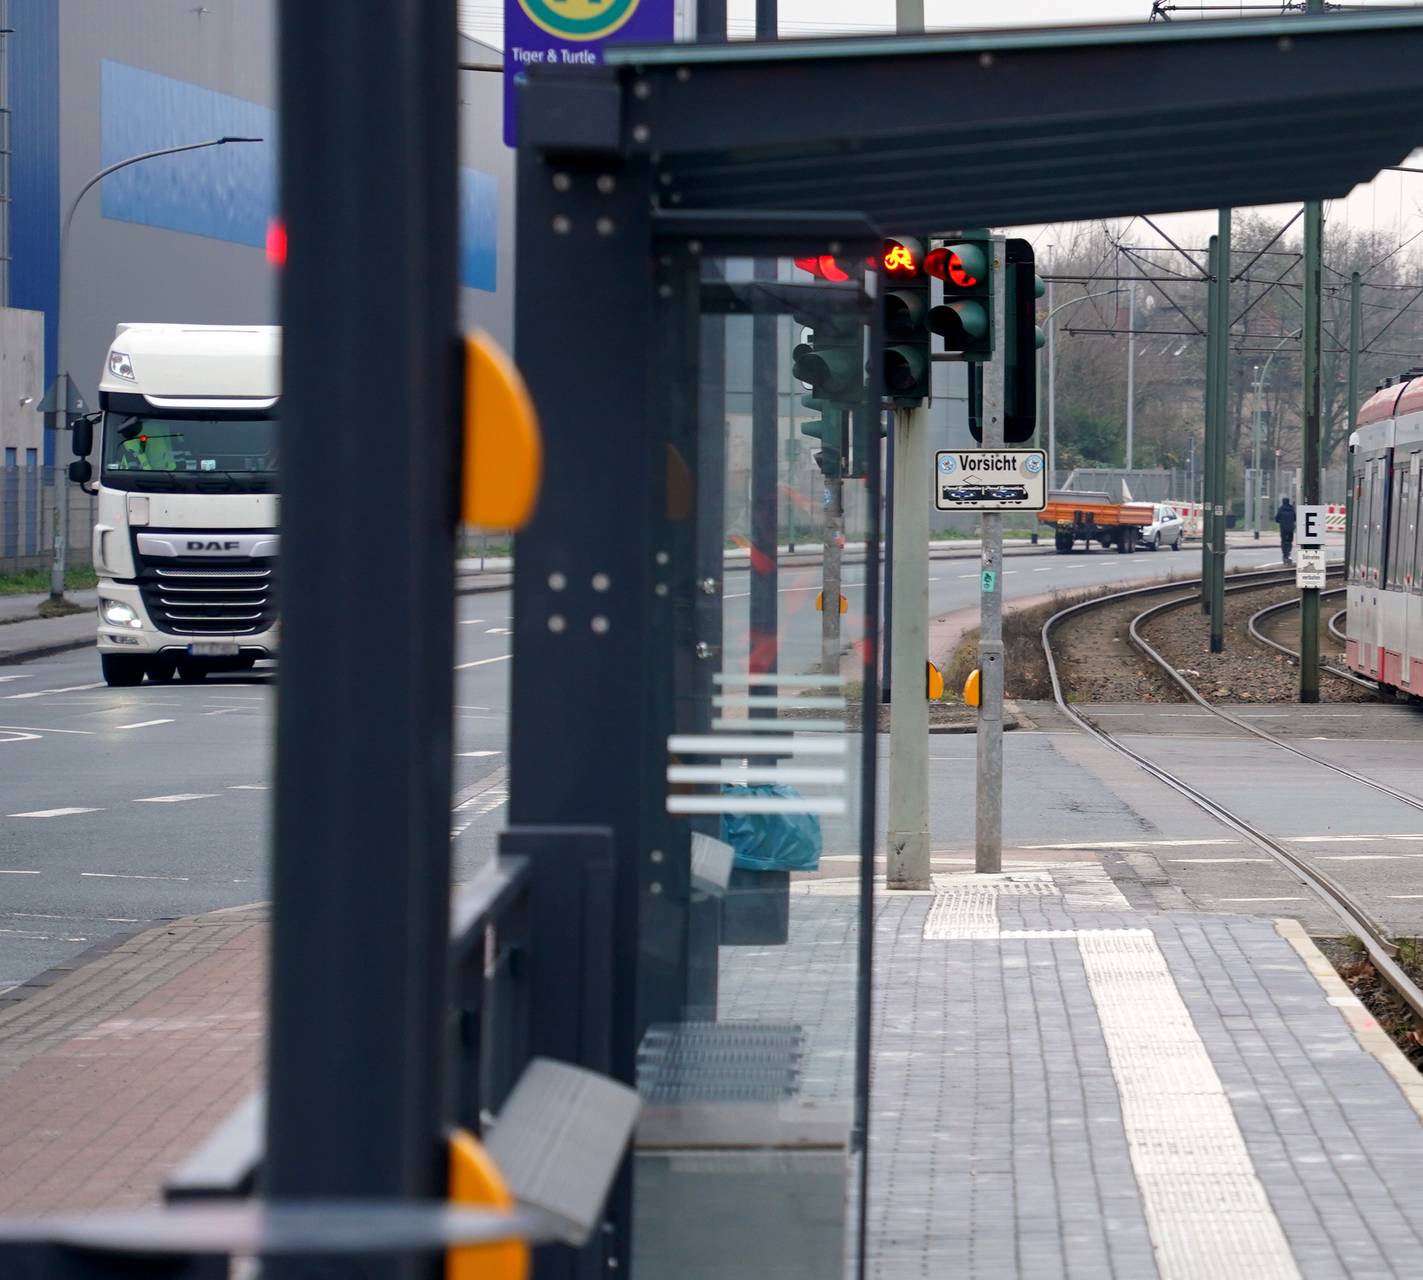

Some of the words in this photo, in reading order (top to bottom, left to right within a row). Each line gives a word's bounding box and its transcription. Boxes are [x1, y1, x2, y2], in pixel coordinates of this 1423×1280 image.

[512, 47, 544, 64] Tiger
[546, 48, 558, 64] &
[560, 49, 596, 65] Turtle
[959, 455, 1017, 471] Vorsicht
[1305, 512, 1318, 537] E
[186, 541, 240, 551] DAF
